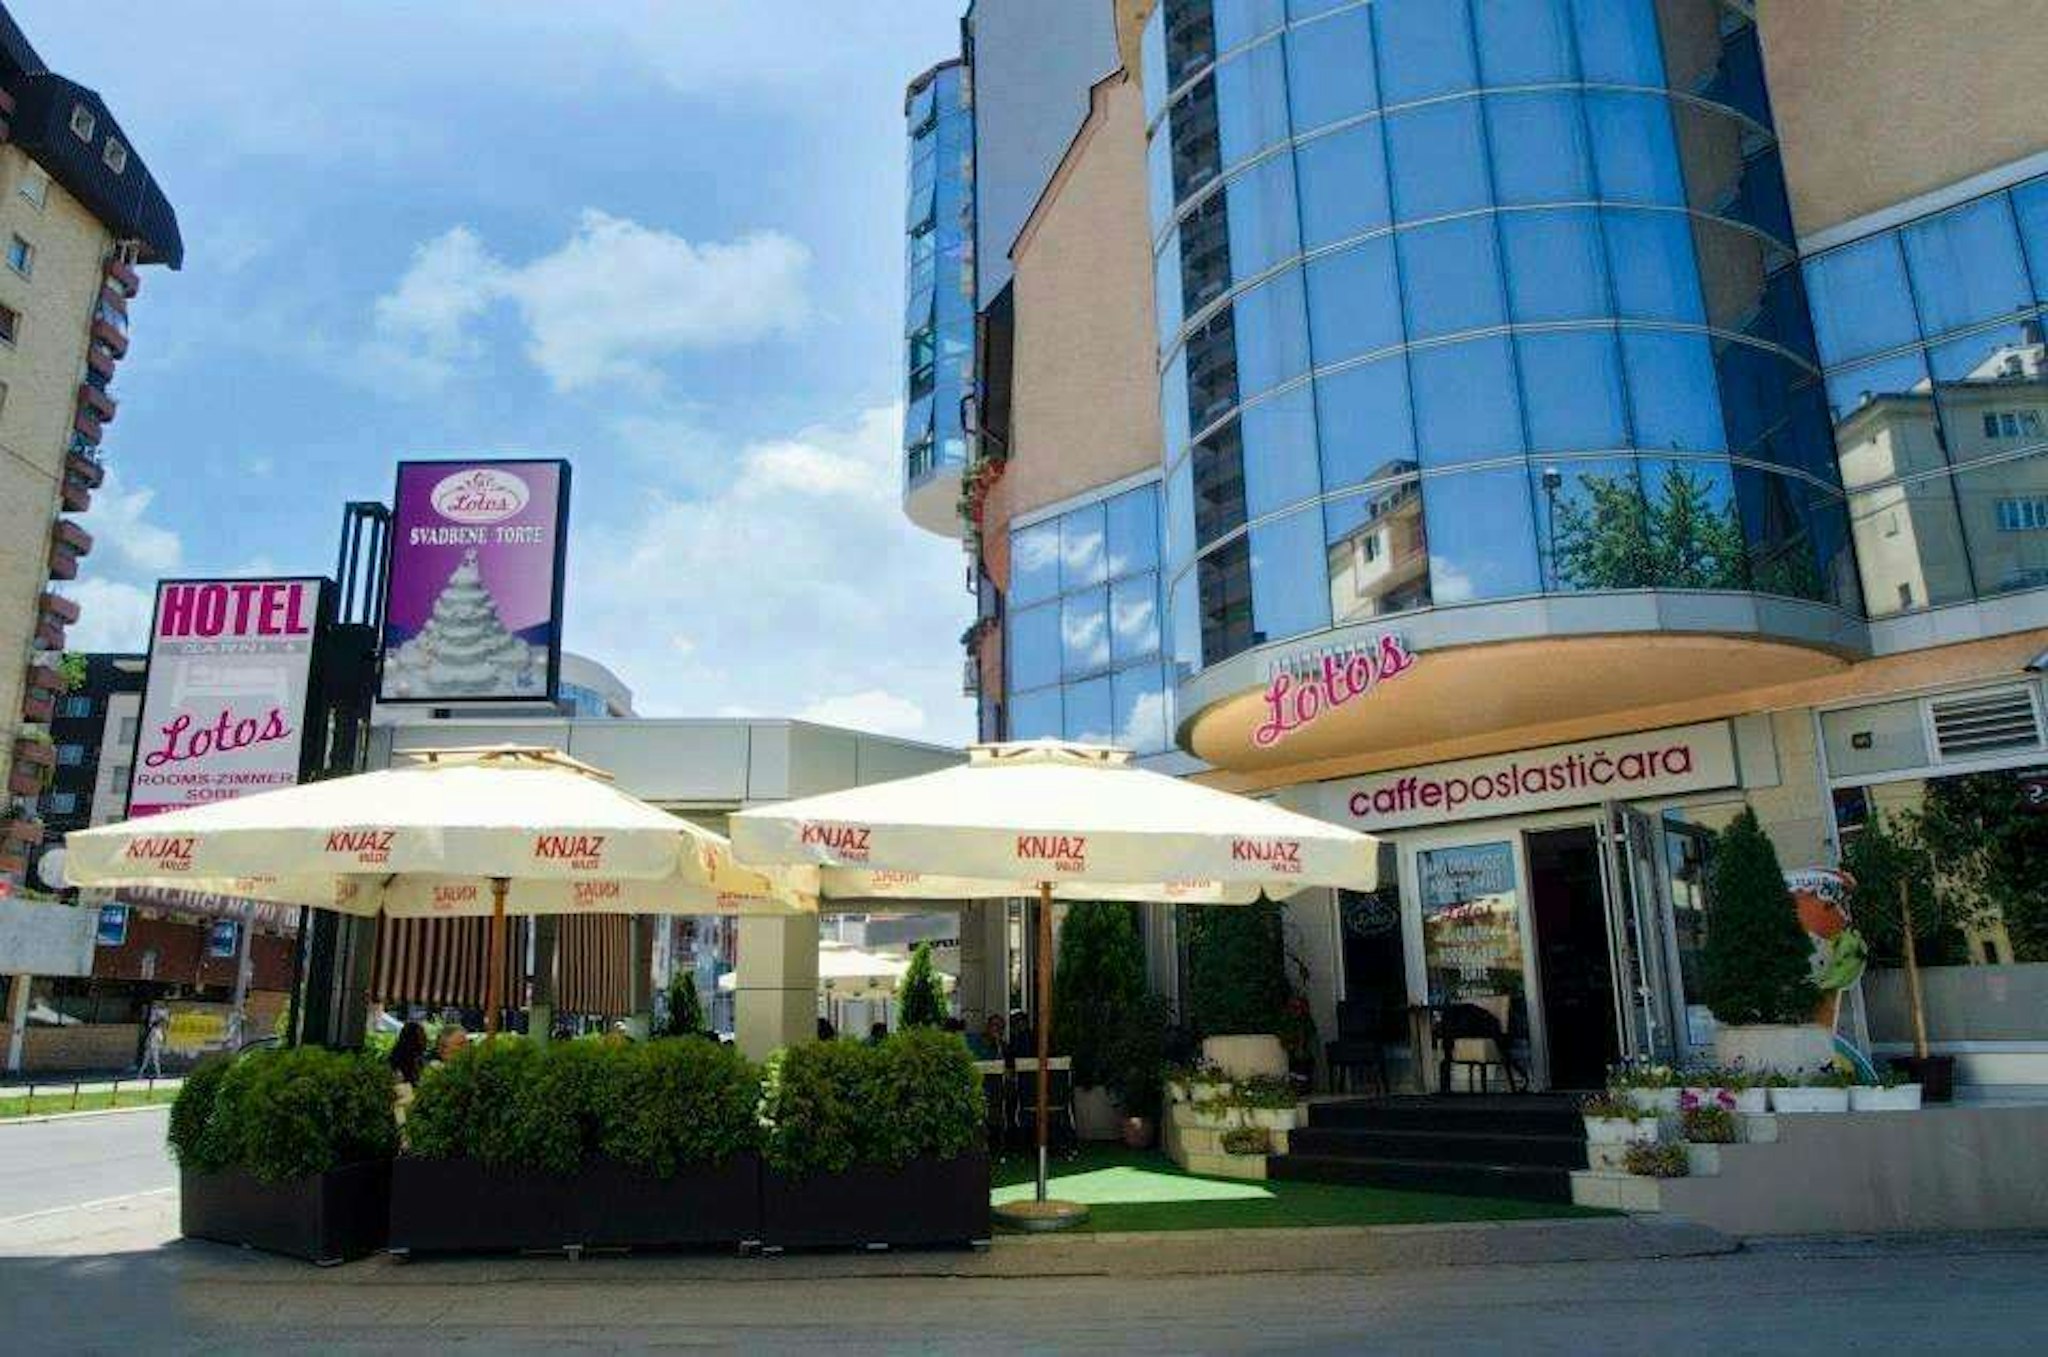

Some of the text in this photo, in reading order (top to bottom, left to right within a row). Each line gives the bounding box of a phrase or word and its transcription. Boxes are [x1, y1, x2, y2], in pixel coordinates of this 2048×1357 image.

[409, 526, 545, 545] SVADBENE TORTE
[161, 584, 309, 637] HOTEL
[1256, 635, 1414, 744] Lotos
[145, 709, 293, 767] Lotos
[138, 773, 295, 786] ROOMS-ZIMMER
[326, 832, 396, 852] KNJAZ
[534, 836, 604, 857] KNJAZ
[802, 824, 871, 850] KNJAZ
[1017, 836, 1084, 858] KNJAZ
[126, 838, 195, 858] KNJAZ
[1232, 840, 1300, 861] KNJAZ
